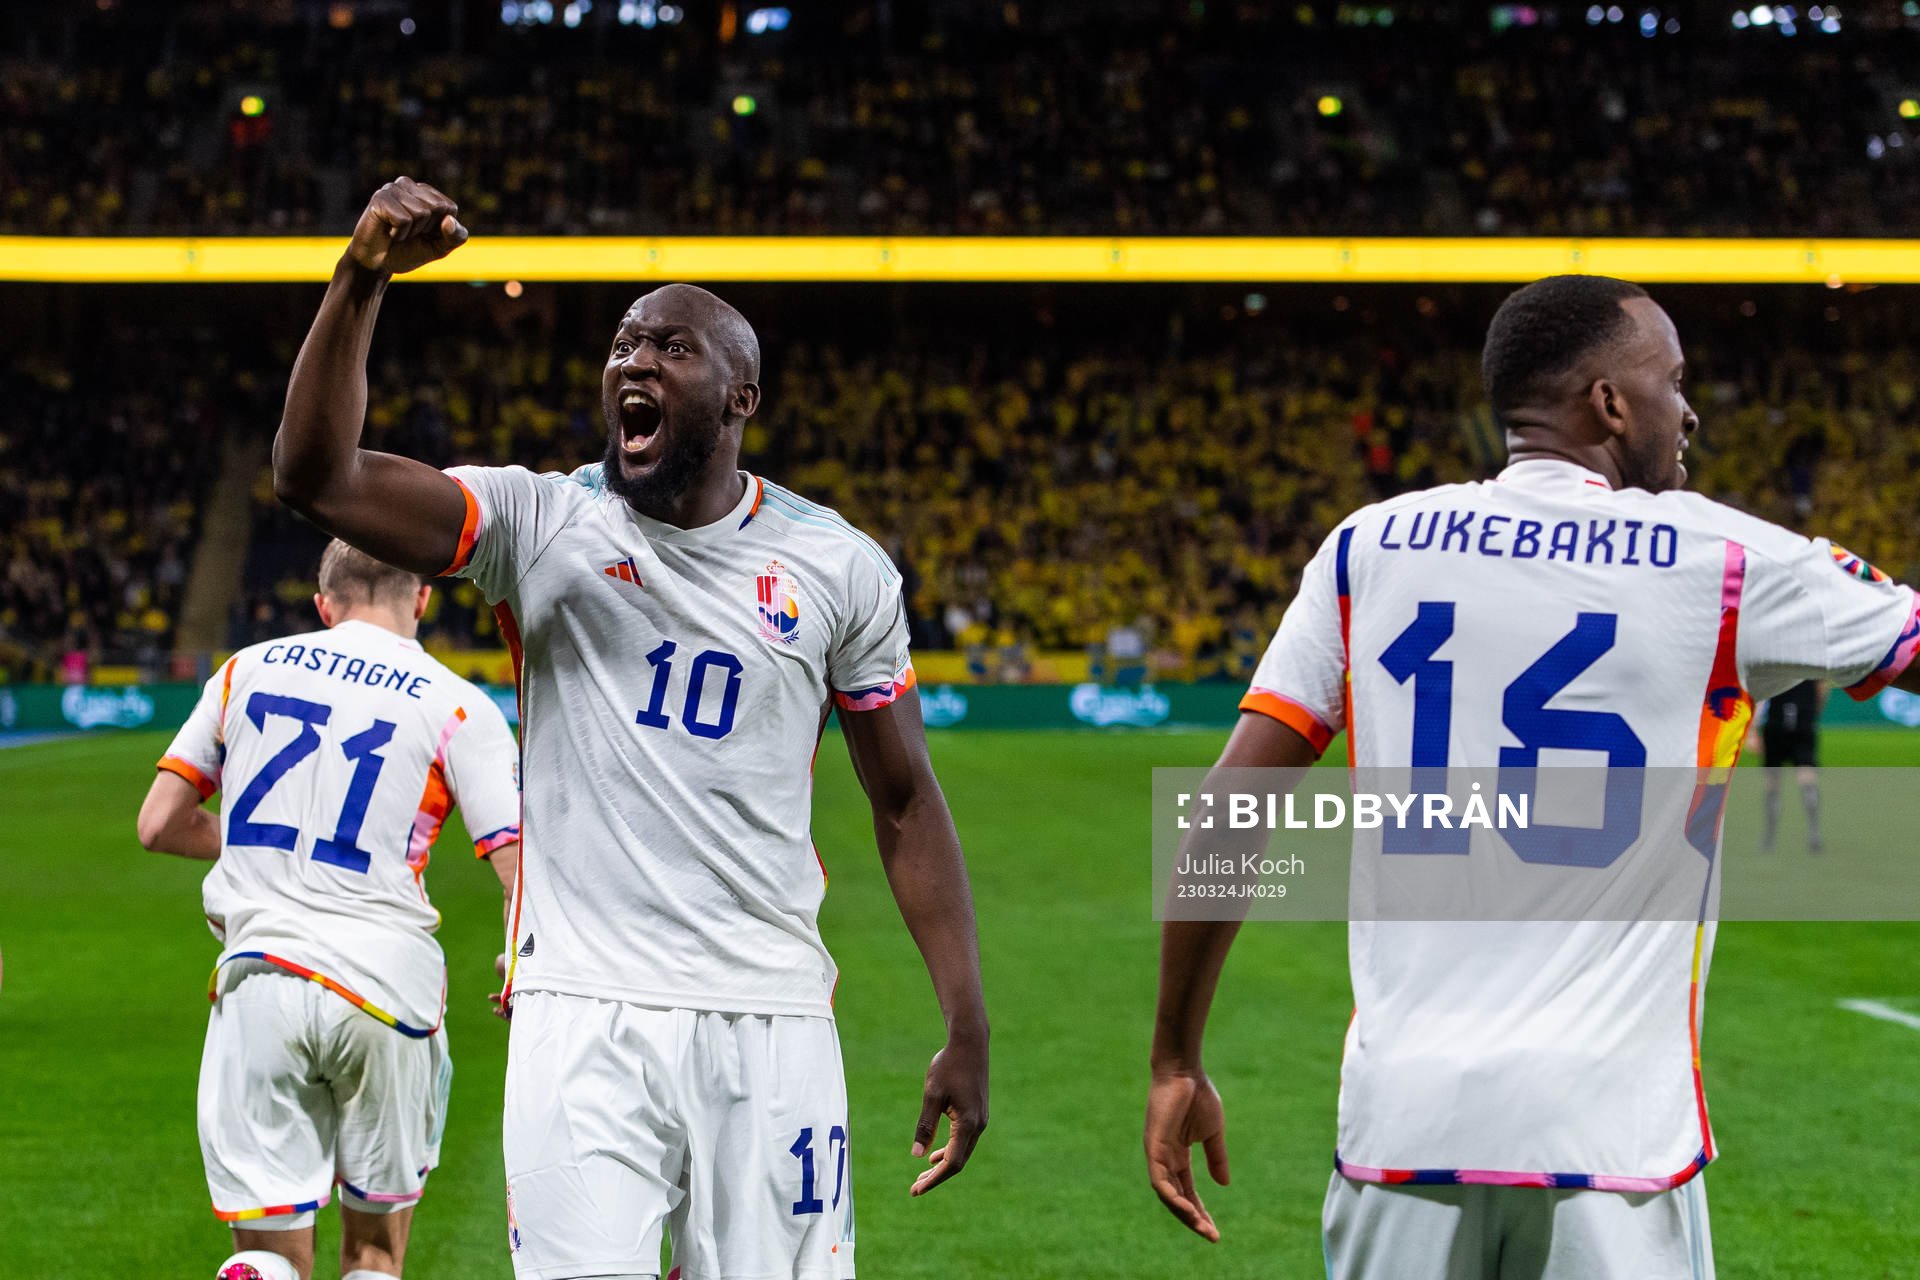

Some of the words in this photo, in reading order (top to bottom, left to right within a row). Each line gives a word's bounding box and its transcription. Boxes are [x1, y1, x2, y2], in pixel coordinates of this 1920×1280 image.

[1379, 511, 1677, 568] LUKEBAKIO
[263, 645, 431, 699] CASTAGNE
[635, 640, 743, 740] 10
[227, 691, 397, 874] 21
[1378, 601, 1647, 868] 16
